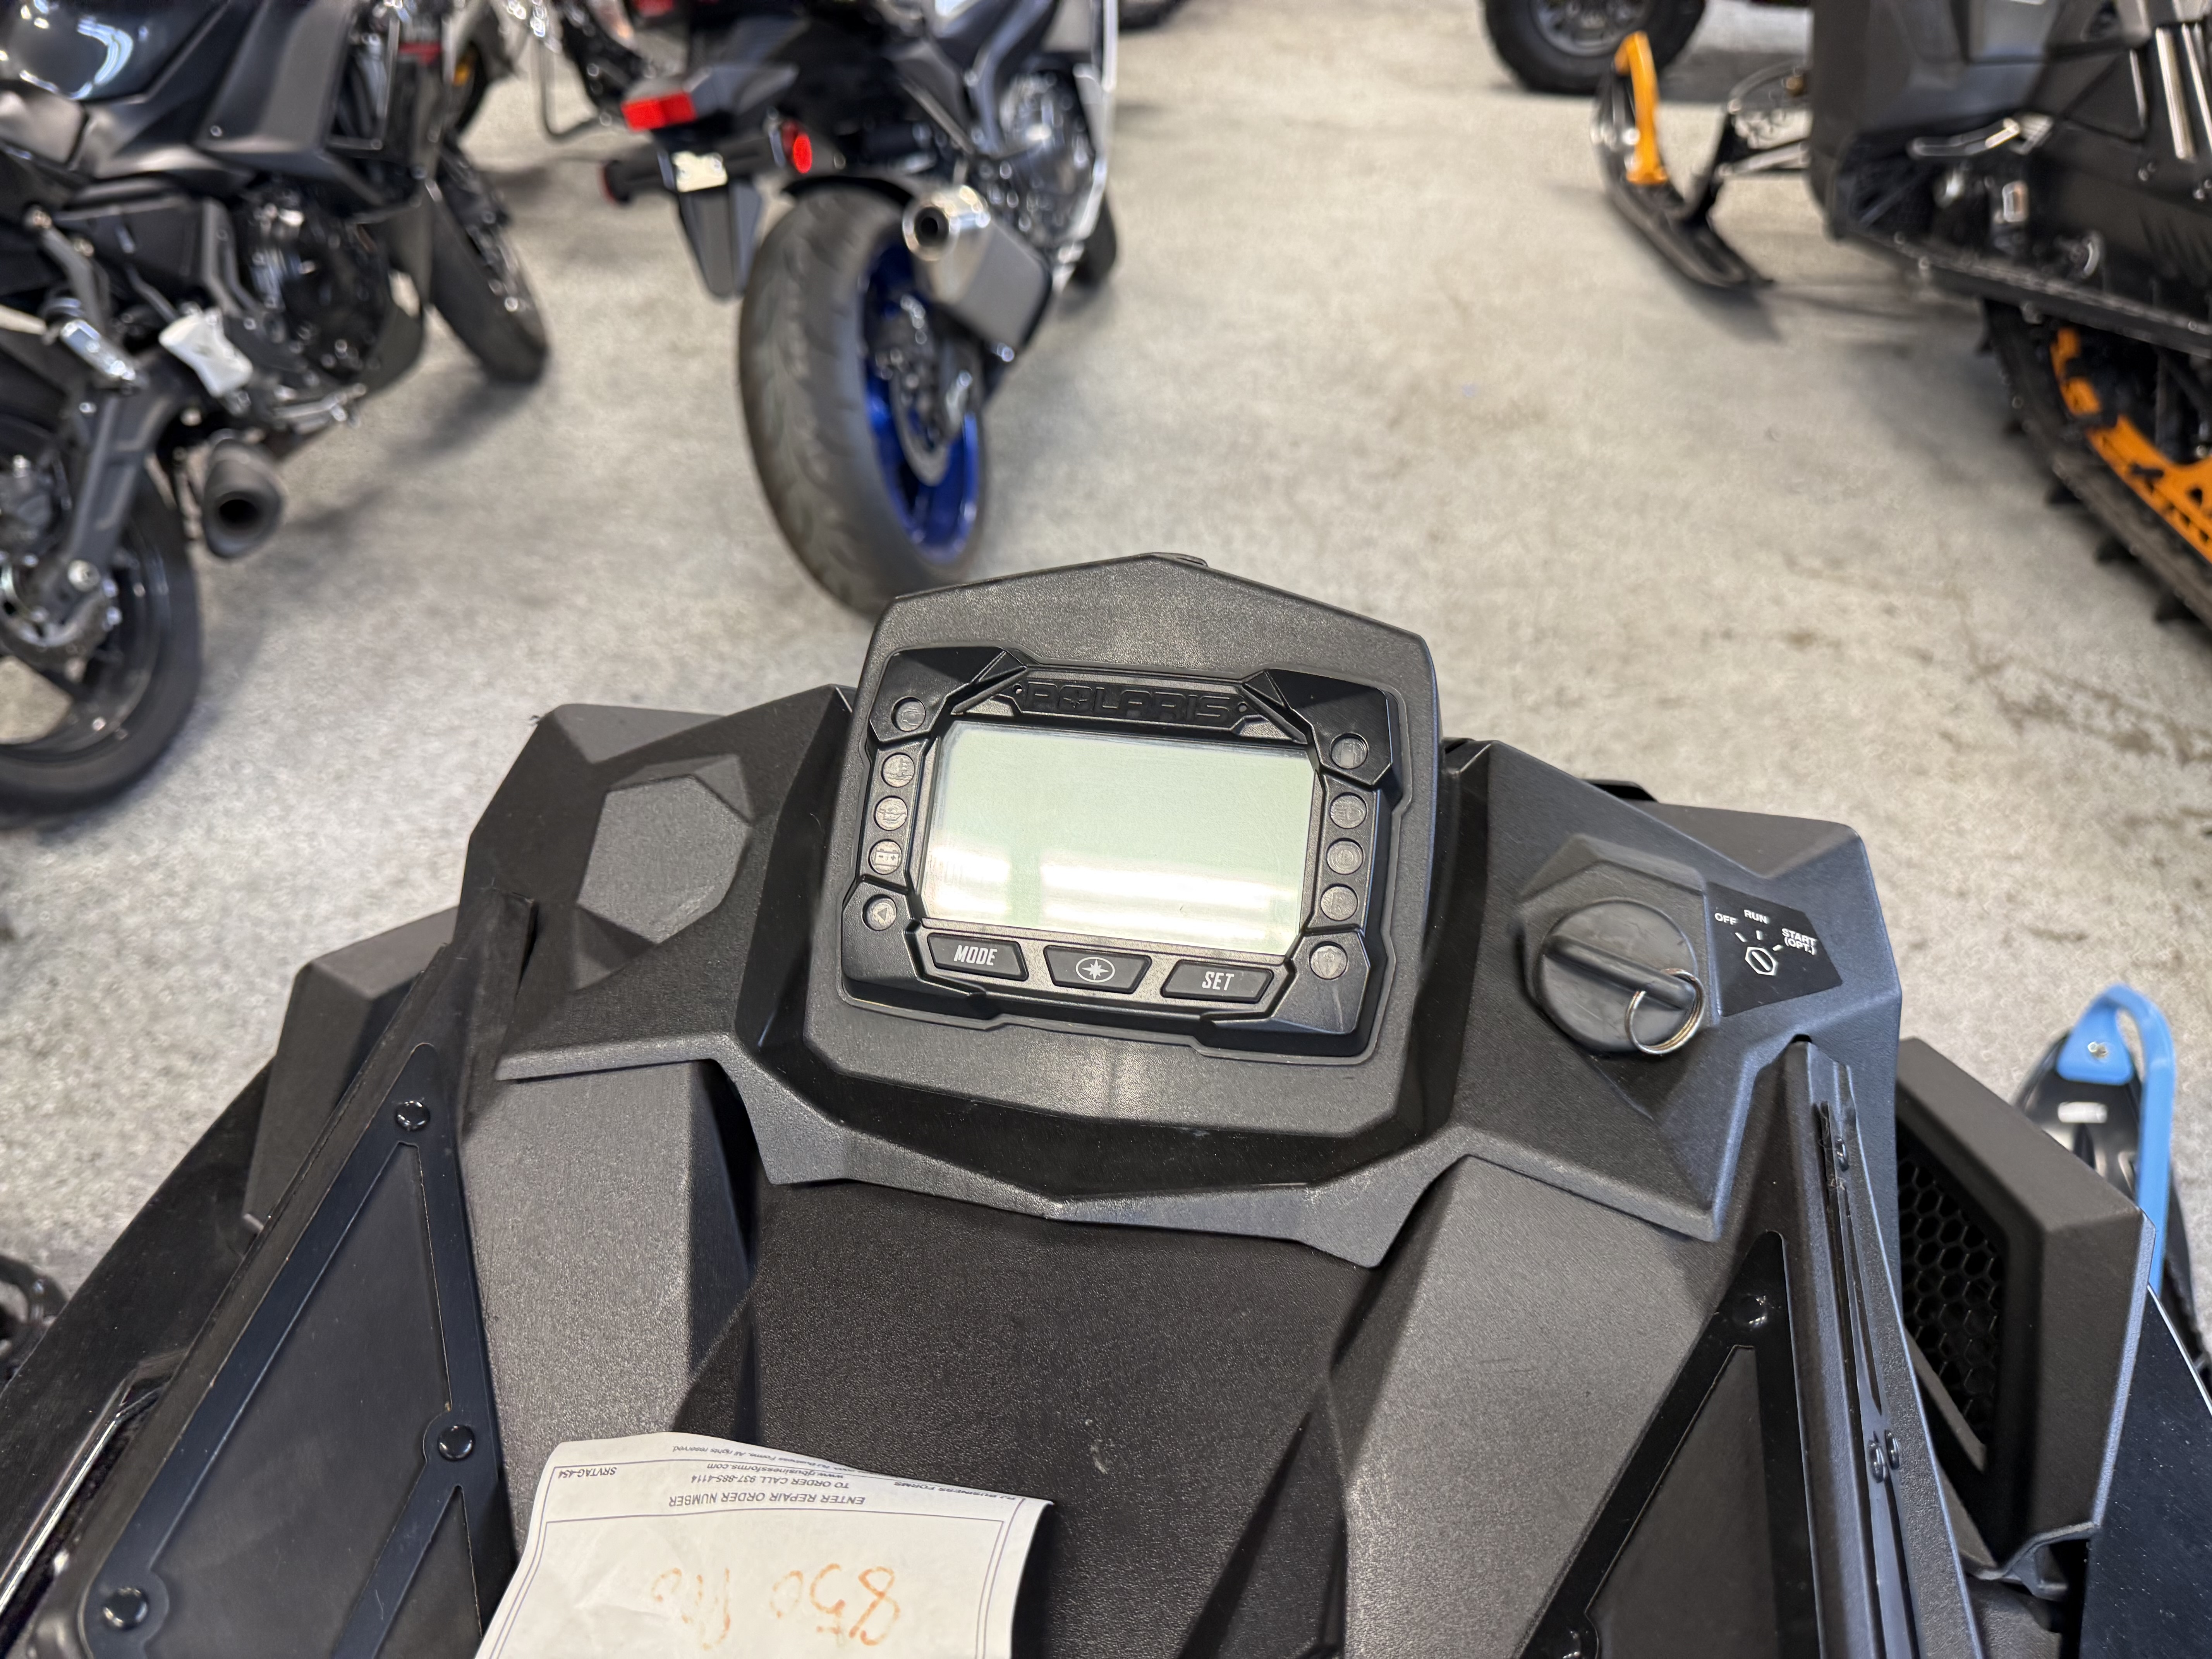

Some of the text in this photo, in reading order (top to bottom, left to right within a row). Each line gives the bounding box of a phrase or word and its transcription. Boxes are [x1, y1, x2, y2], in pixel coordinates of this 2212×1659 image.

[1023, 681, 1231, 723] POLARIS
[1714, 913, 1738, 925] OFF
[1744, 909, 1769, 924] RUN
[1782, 928, 1817, 946] START
[1784, 936, 1817, 955] (OPT.)
[954, 945, 998, 966] MODE
[1202, 971, 1234, 991] SET
[707, 1463, 843, 1479] www.rjbusinessforms.com
[790, 1478, 831, 1487] ORDER
[668, 1492, 866, 1507] ENTER REPAIR ORDER NUMBER
[769, 1563, 900, 1647] 850
